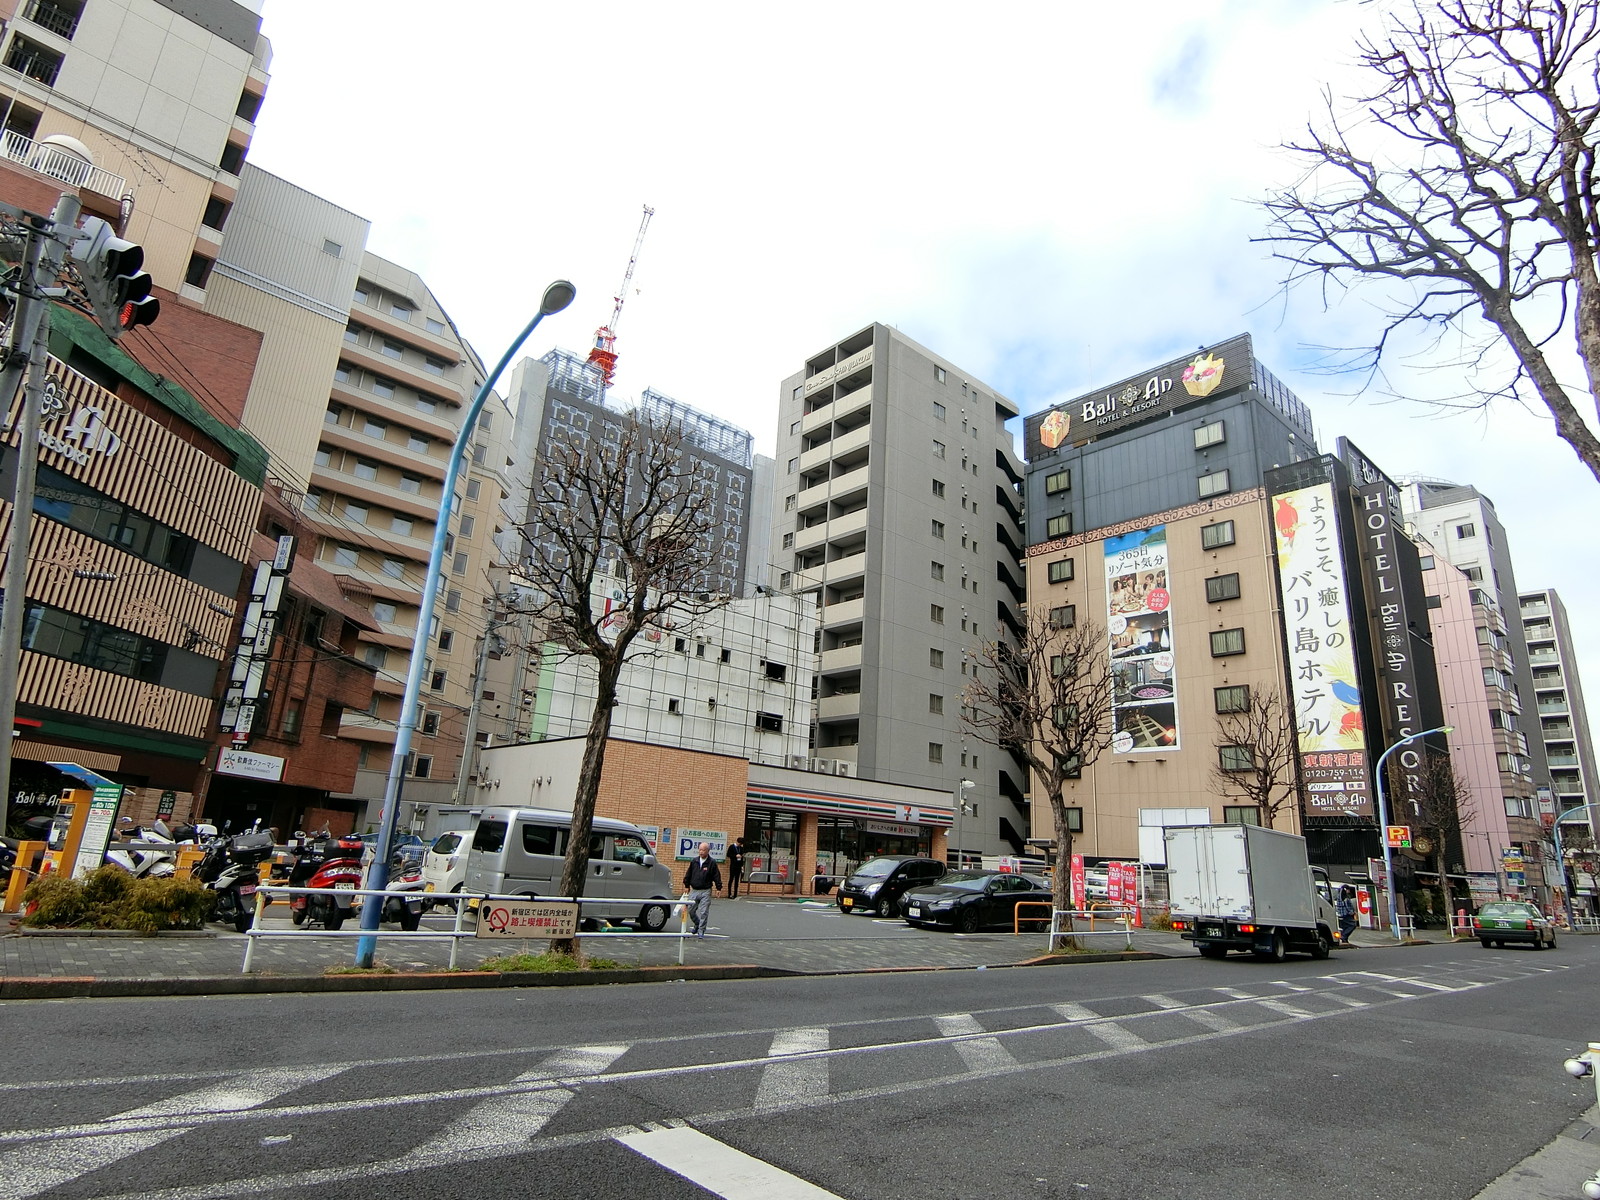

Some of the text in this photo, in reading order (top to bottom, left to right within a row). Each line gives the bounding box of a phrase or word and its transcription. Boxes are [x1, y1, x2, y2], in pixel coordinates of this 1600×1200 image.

[1080, 376, 1173, 422] Bali An
[1096, 413, 1120, 426] HOTEL
[1131, 398, 1161, 414] RESORT
[64, 406, 121, 457] An
[39, 428, 90, 467] RESORT
[1363, 493, 1394, 593] HOTEL
[1118, 545, 1148, 562] 365日
[1108, 554, 1165, 576] リゾート気分
[1309, 495, 1346, 649] ようこそ、癒しの
[1380, 602, 1406, 671] Bali An
[1286, 570, 1331, 741] バリ島ホテル
[1393, 682, 1422, 817] RESORT
[237, 756, 280, 769] 歌舞伎ファーマシー
[1304, 752, 1363, 768] 東新宿店
[1305, 768, 1364, 777] 0120-759-114
[15, 791, 61, 806] Bali An
[1311, 793, 1366, 806] Bali An
[1388, 828, 1404, 840] P
[680, 838, 693, 856] P
[510, 917, 574, 927] 路上喫煙禁止です。
[511, 908, 574, 917] 新宿区では区内全域が
